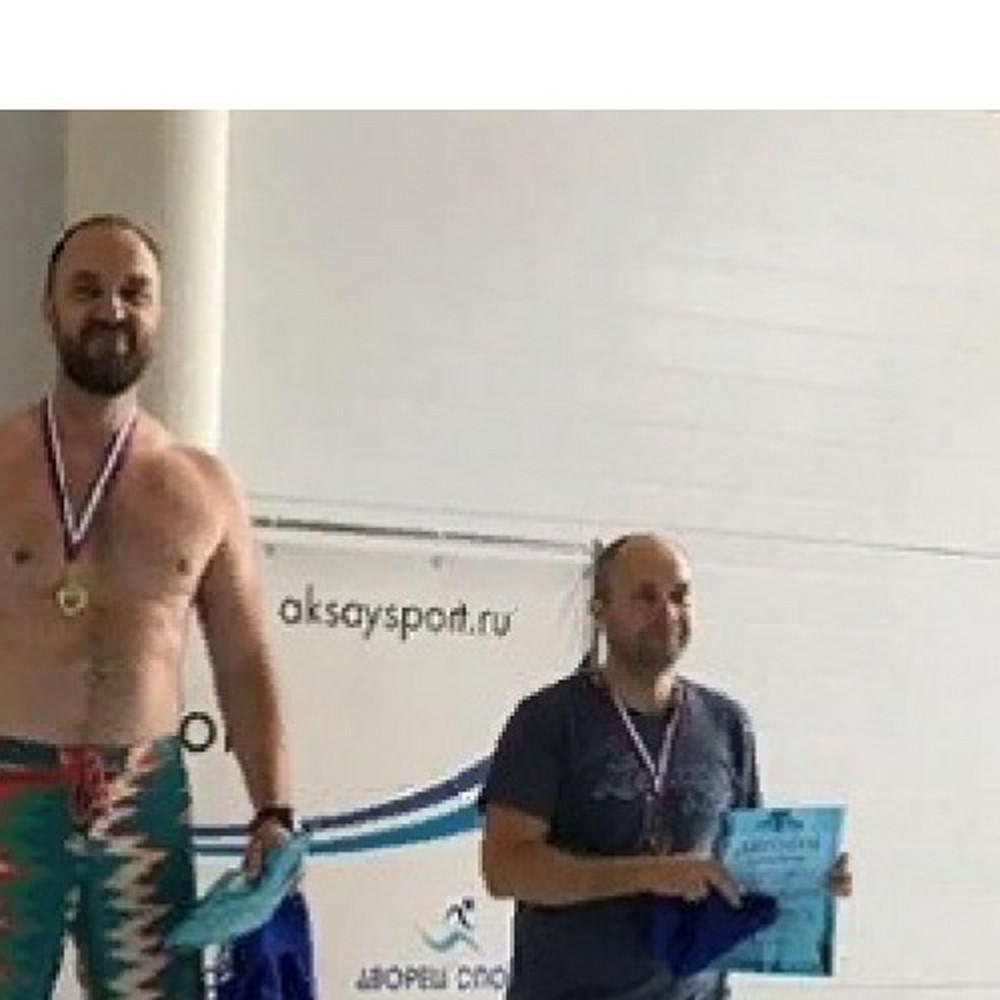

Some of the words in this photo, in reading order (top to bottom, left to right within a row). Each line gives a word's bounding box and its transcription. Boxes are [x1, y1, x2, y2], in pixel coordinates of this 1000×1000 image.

[278, 584, 513, 642] aksaysport.ru
[356, 965, 447, 990] ДВОРЕЦ
[456, 965, 507, 990] СПО
